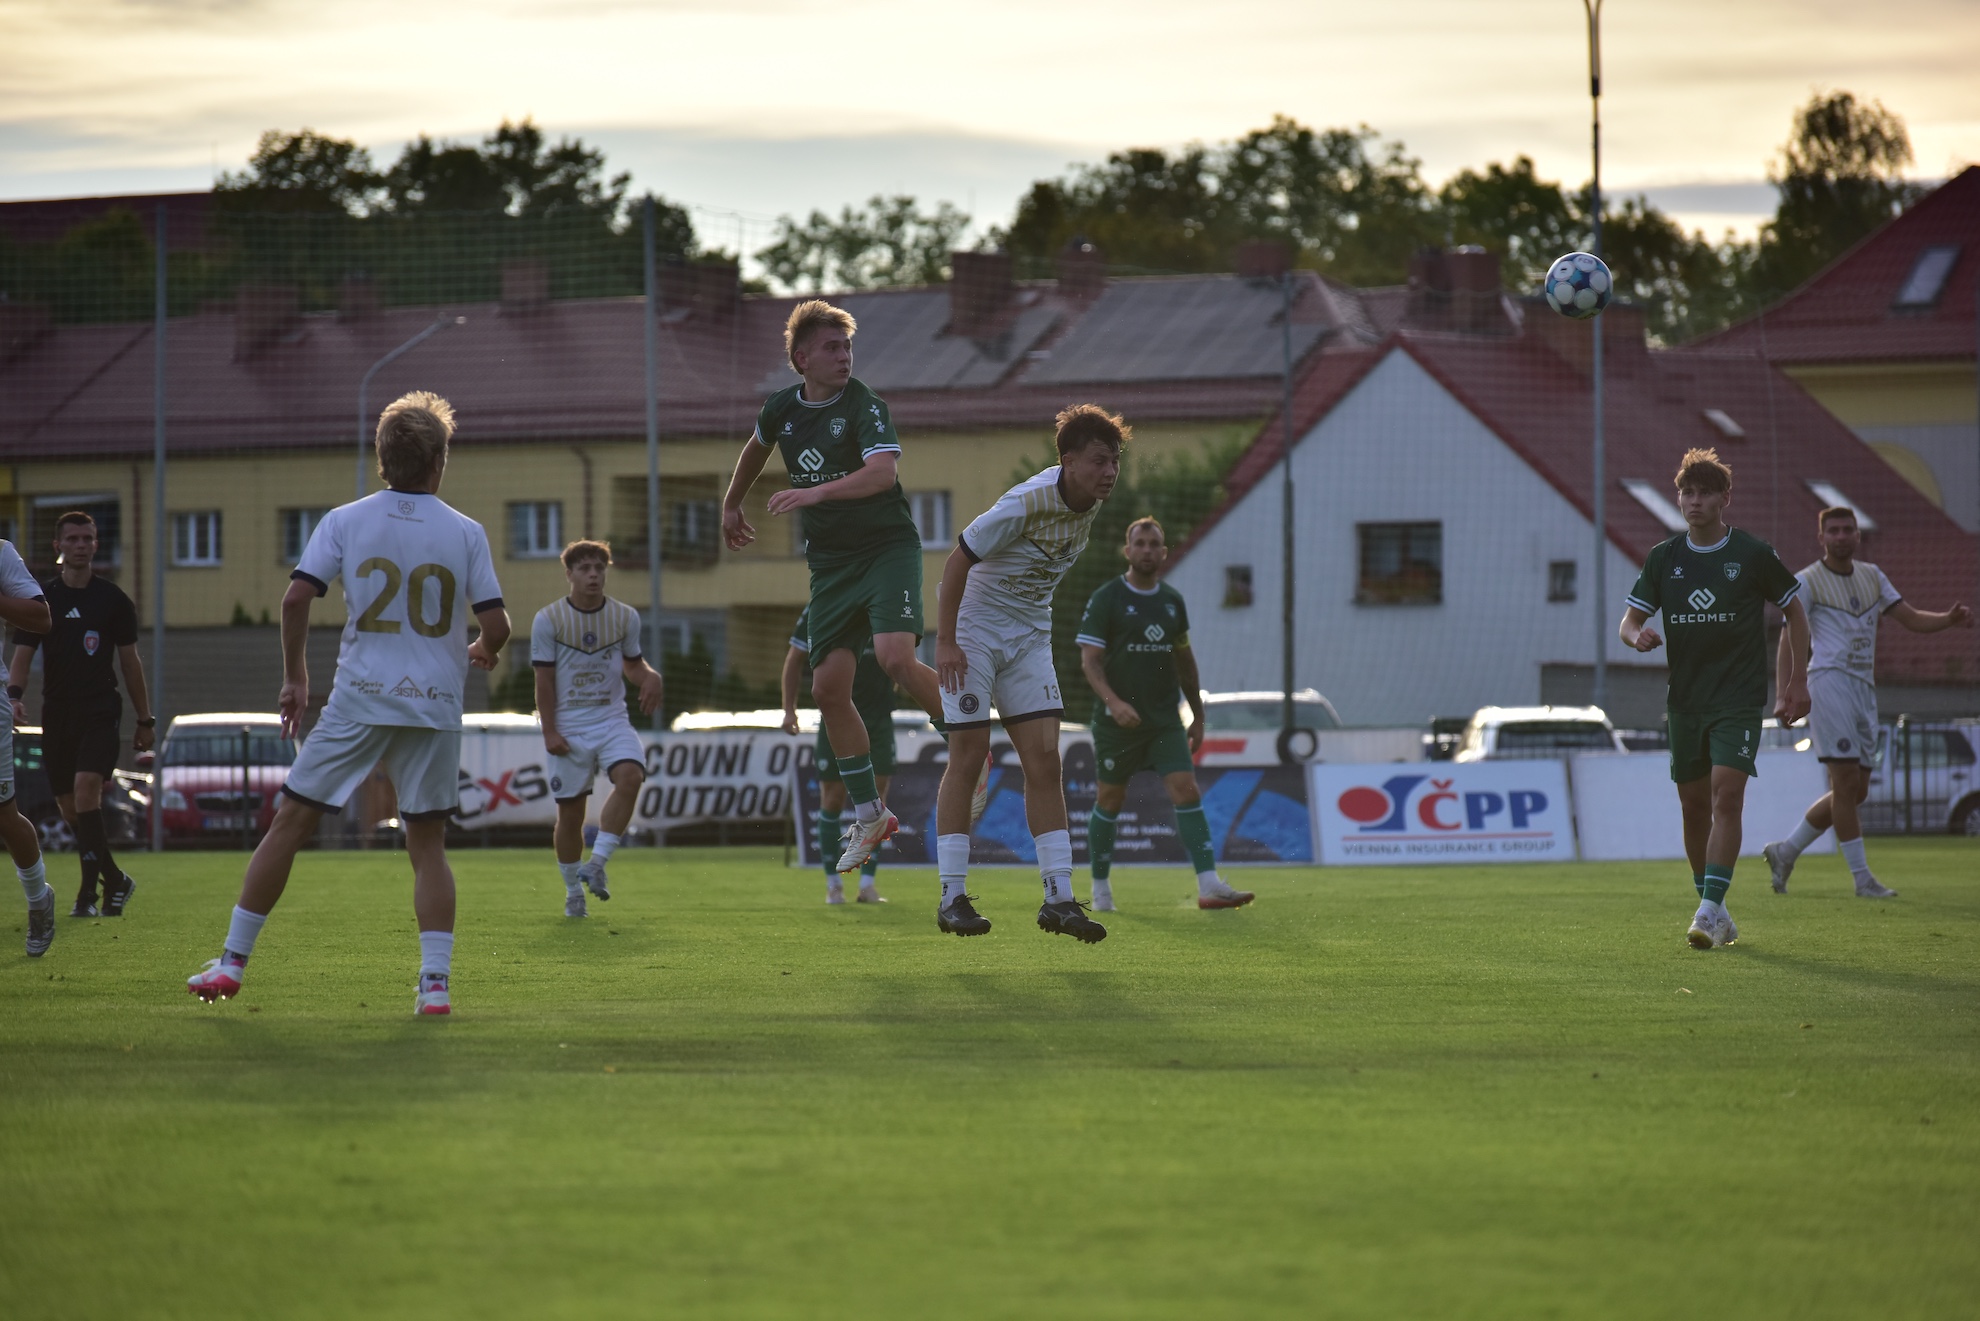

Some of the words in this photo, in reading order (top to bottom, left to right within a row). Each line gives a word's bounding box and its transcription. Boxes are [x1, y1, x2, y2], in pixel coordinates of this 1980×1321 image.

[355, 557, 456, 638] 20
[903, 590, 910, 602] 2
[1670, 612, 1736, 624] ČECOMET
[1043, 685, 1060, 700] 13
[1418, 779, 1549, 831] ČPP
[1342, 842, 1400, 855] VIENNA
[1406, 841, 1495, 855] INSURANCE
[1501, 840, 1556, 853] GROUP
